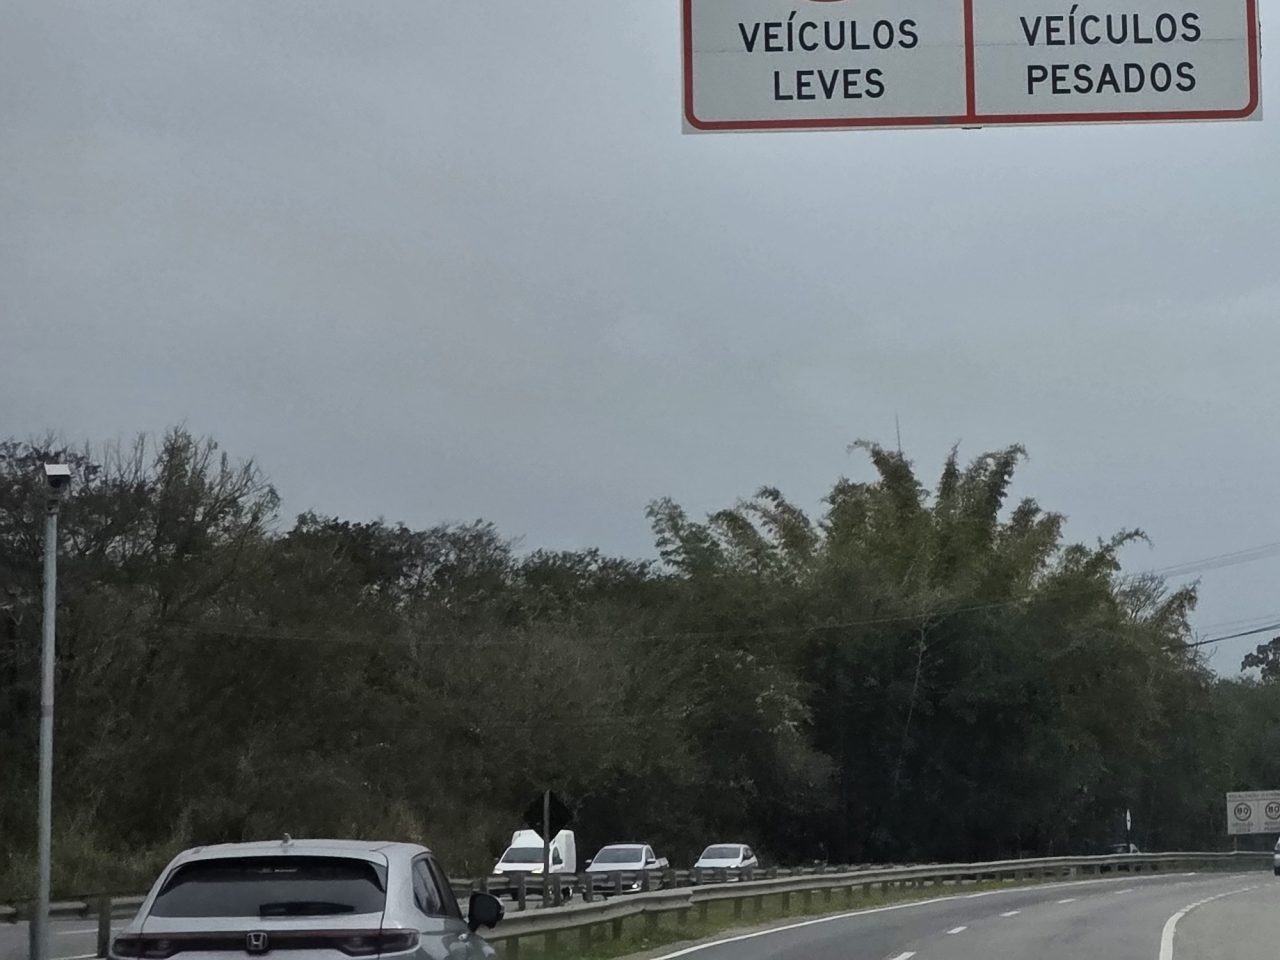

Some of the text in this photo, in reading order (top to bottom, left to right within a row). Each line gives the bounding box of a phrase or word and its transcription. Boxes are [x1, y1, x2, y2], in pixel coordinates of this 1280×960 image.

[738, 11, 919, 53] VEÍCULOS
[1019, 4, 1202, 47] VEÍCULOS
[773, 68, 886, 101] LEVES
[1027, 62, 1197, 95] PESADOS
